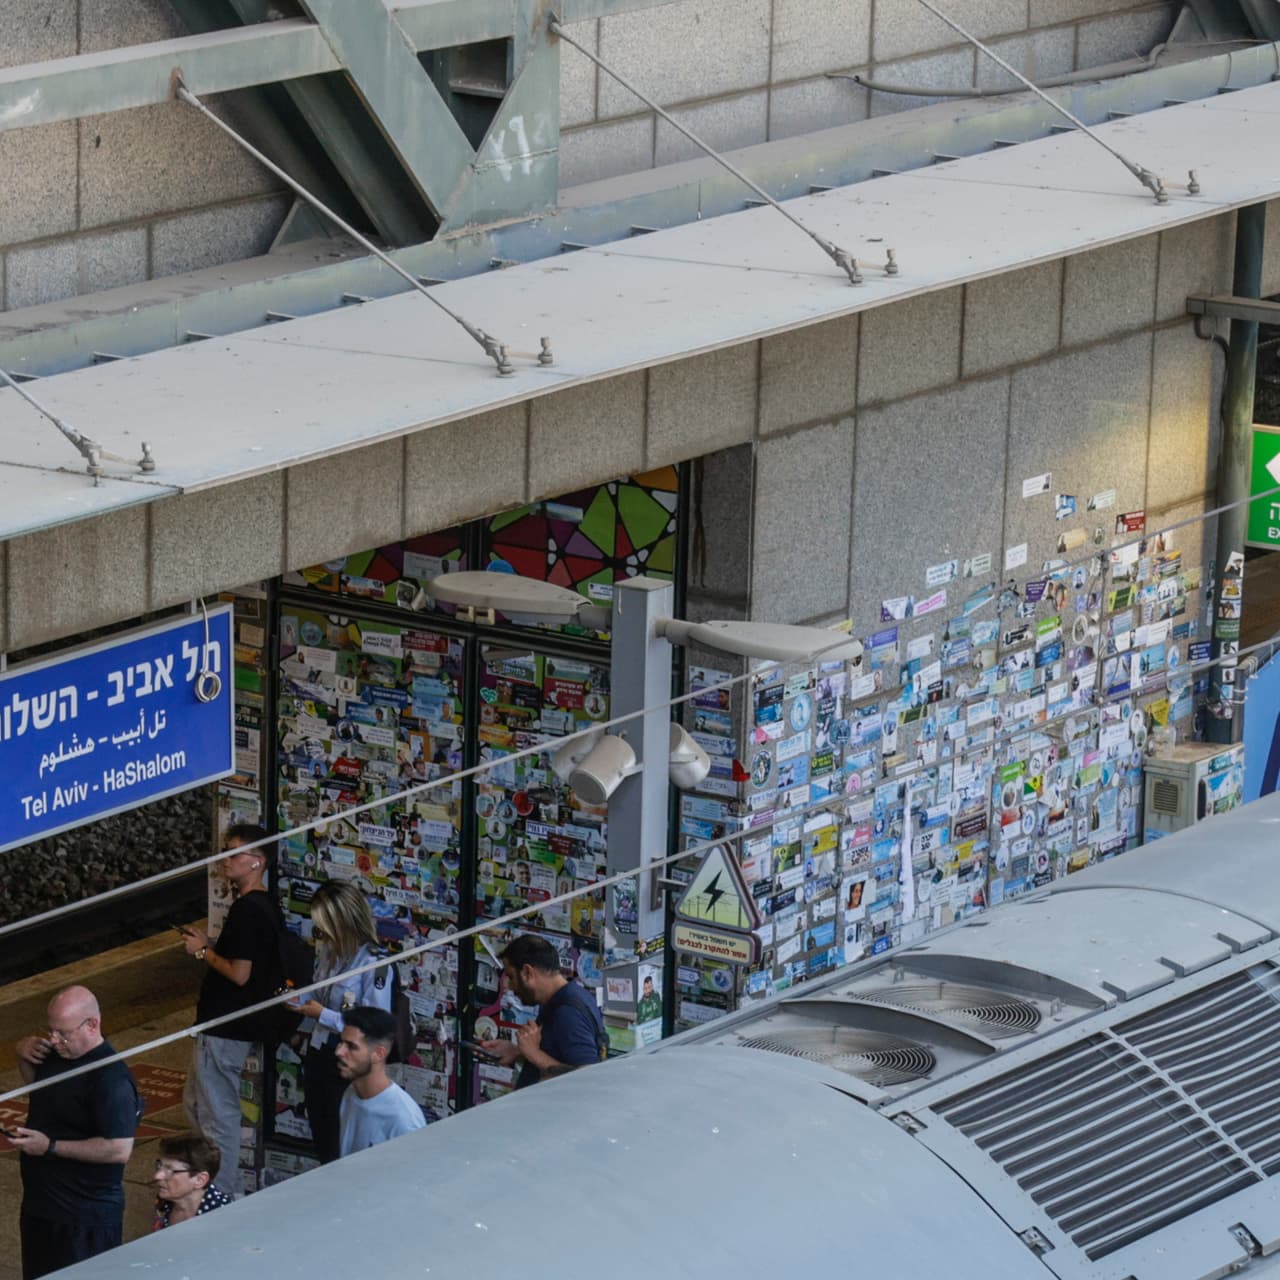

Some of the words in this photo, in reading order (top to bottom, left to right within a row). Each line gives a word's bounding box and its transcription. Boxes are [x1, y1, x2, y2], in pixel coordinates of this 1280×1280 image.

[107, 653, 175, 707] אביב
[181, 640, 221, 682] תל
[112, 708, 145, 749] أبيب
[148, 708, 167, 740] تل
[39, 733, 95, 779] هشلوم
[21, 792, 47, 820] Tel
[52, 782, 89, 811] Aviv
[103, 750, 187, 794] HaShalom
